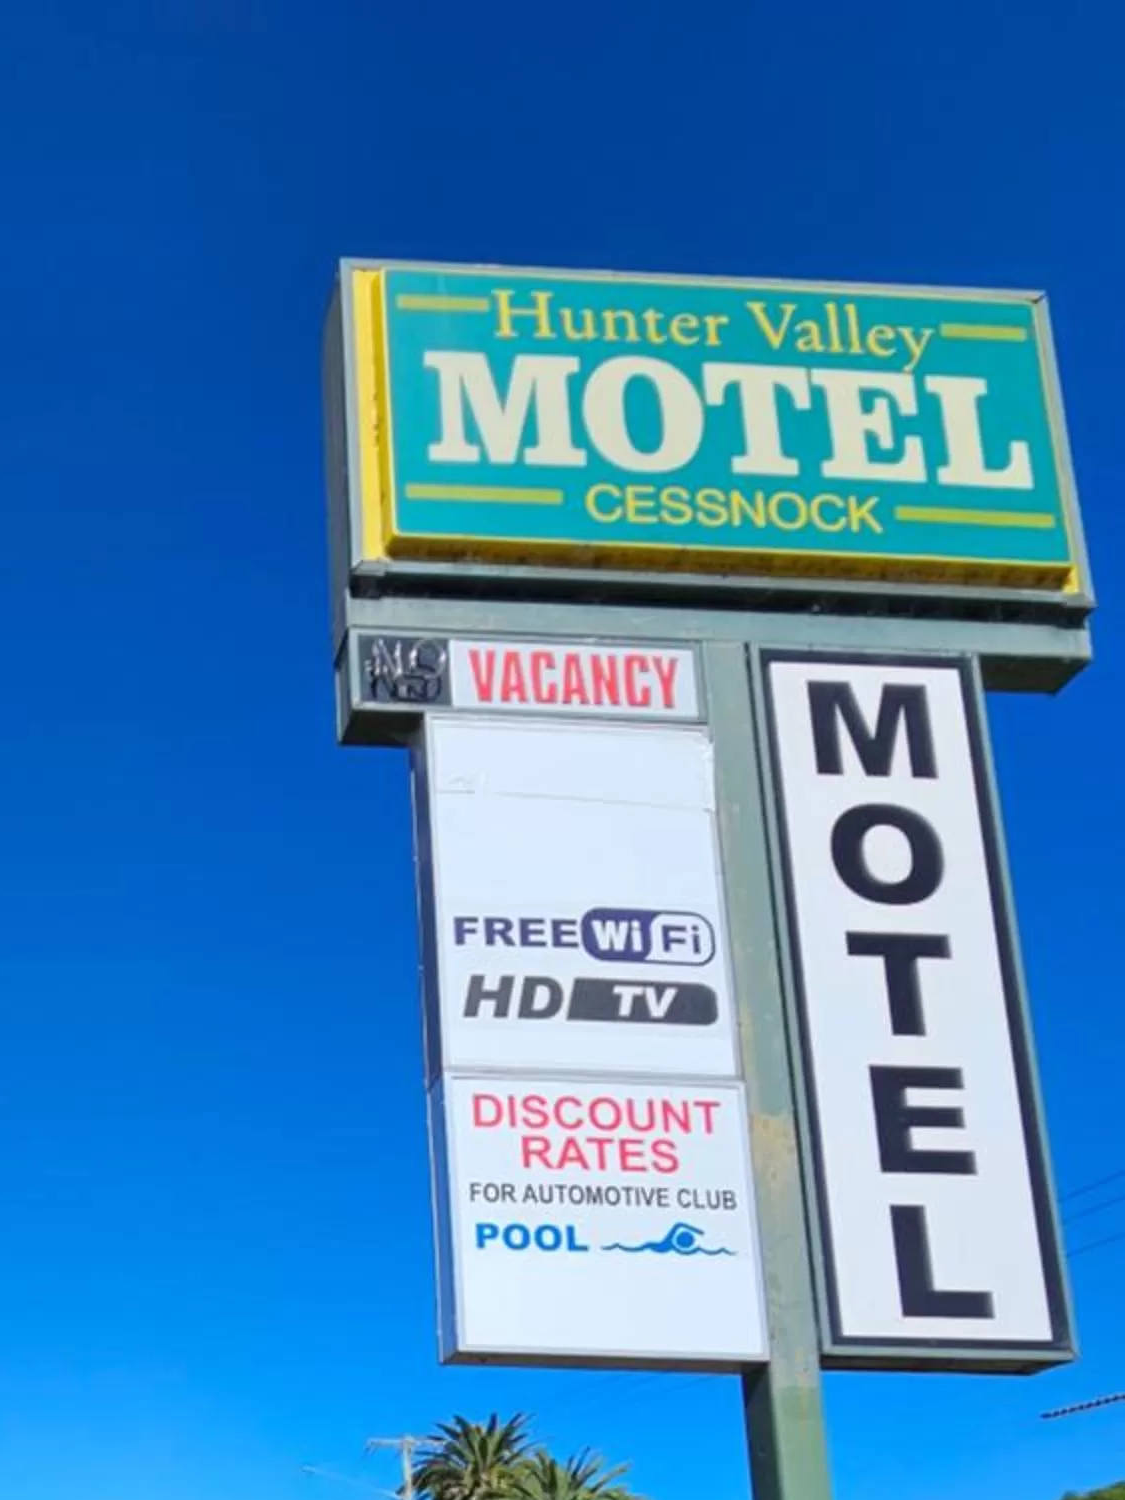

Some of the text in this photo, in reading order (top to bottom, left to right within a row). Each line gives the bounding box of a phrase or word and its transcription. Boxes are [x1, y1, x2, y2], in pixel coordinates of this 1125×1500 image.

[491, 290, 933, 374] Hunter Valley
[424, 350, 1035, 490] MOTEL
[584, 483, 883, 533] CESSNOCK
[469, 649, 679, 708] VACANCY
[453, 916, 579, 948] FREE
[806, 680, 995, 1320] MOTEL
[472, 1094, 720, 1134] DISCOUNT
[521, 1136, 679, 1173] RATES
[470, 1182, 737, 1210] FOR AUTOMOTIVE CLUB
[475, 1223, 589, 1251] POOL
